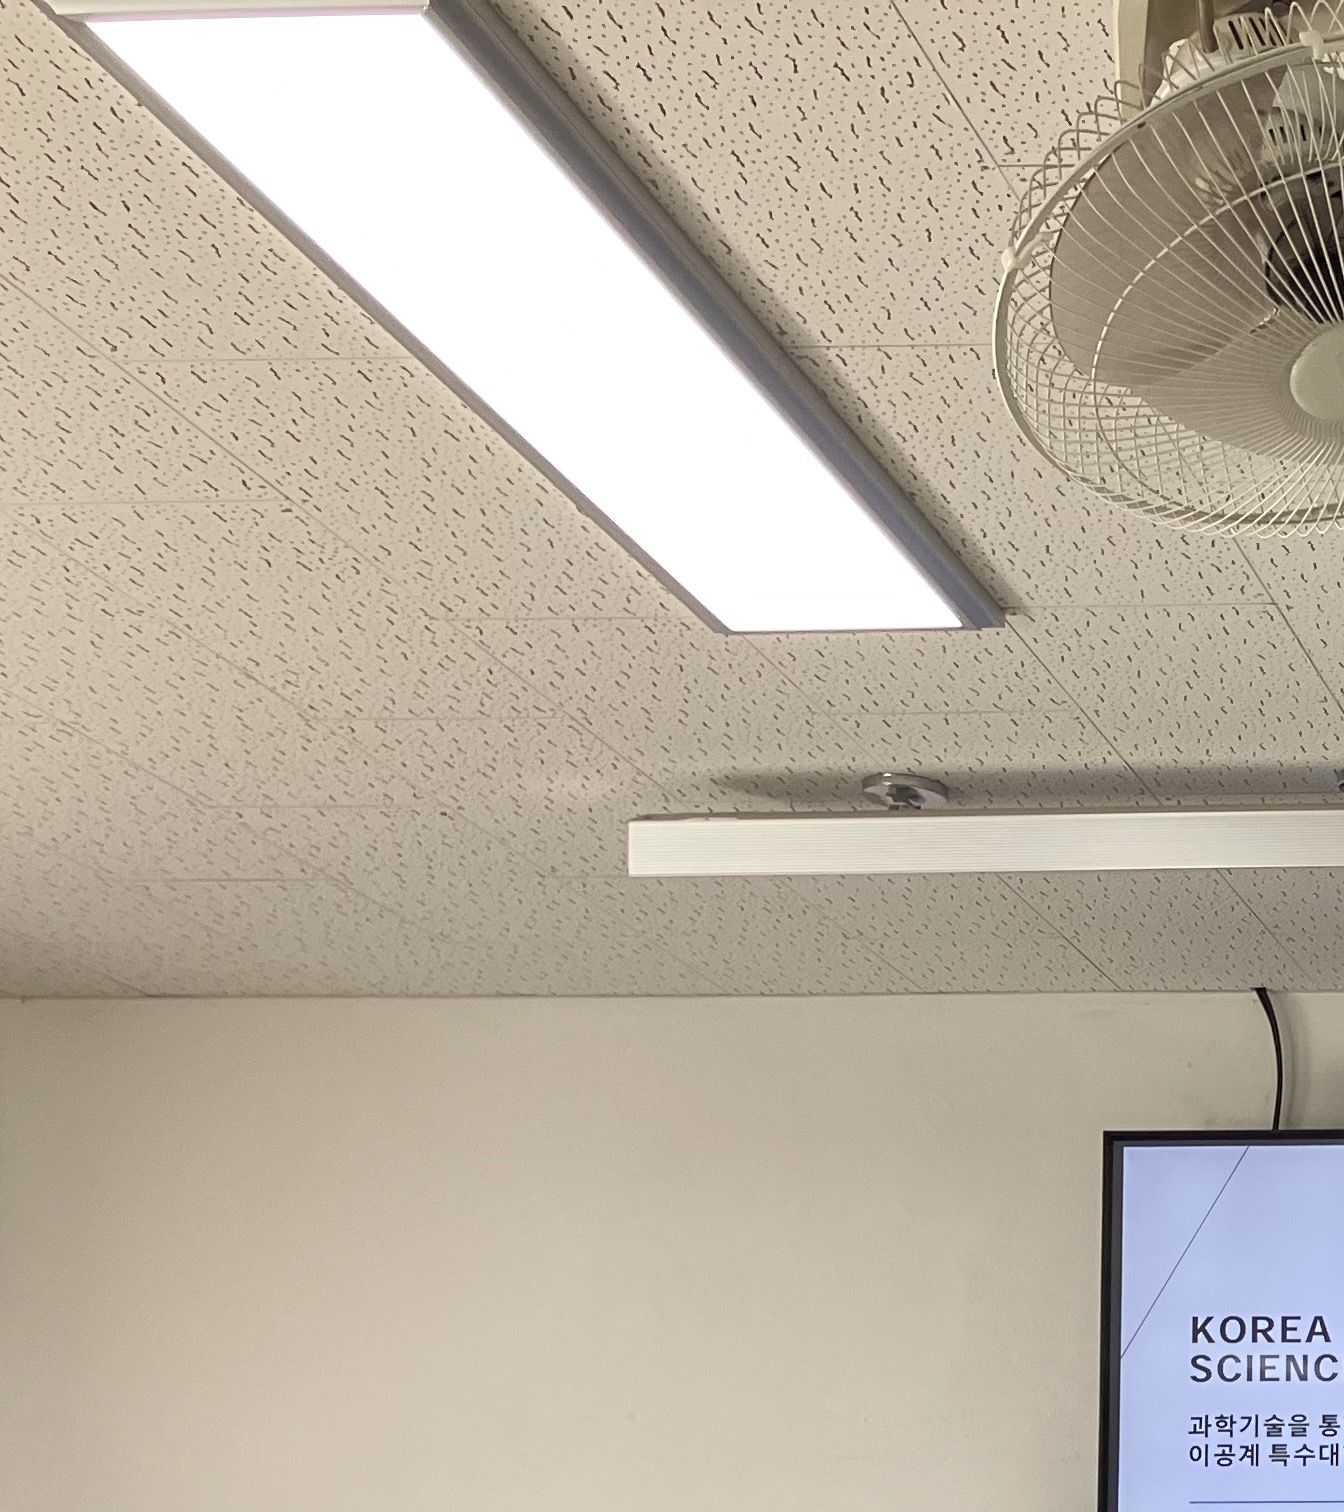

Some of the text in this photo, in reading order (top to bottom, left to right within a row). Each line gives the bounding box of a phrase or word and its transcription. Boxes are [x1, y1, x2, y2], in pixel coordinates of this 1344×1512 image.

[1191, 1315, 1331, 1344] KOREA
[1188, 1414, 1310, 1438] 과학기술을
[1189, 1444, 1260, 1468] 이공계
